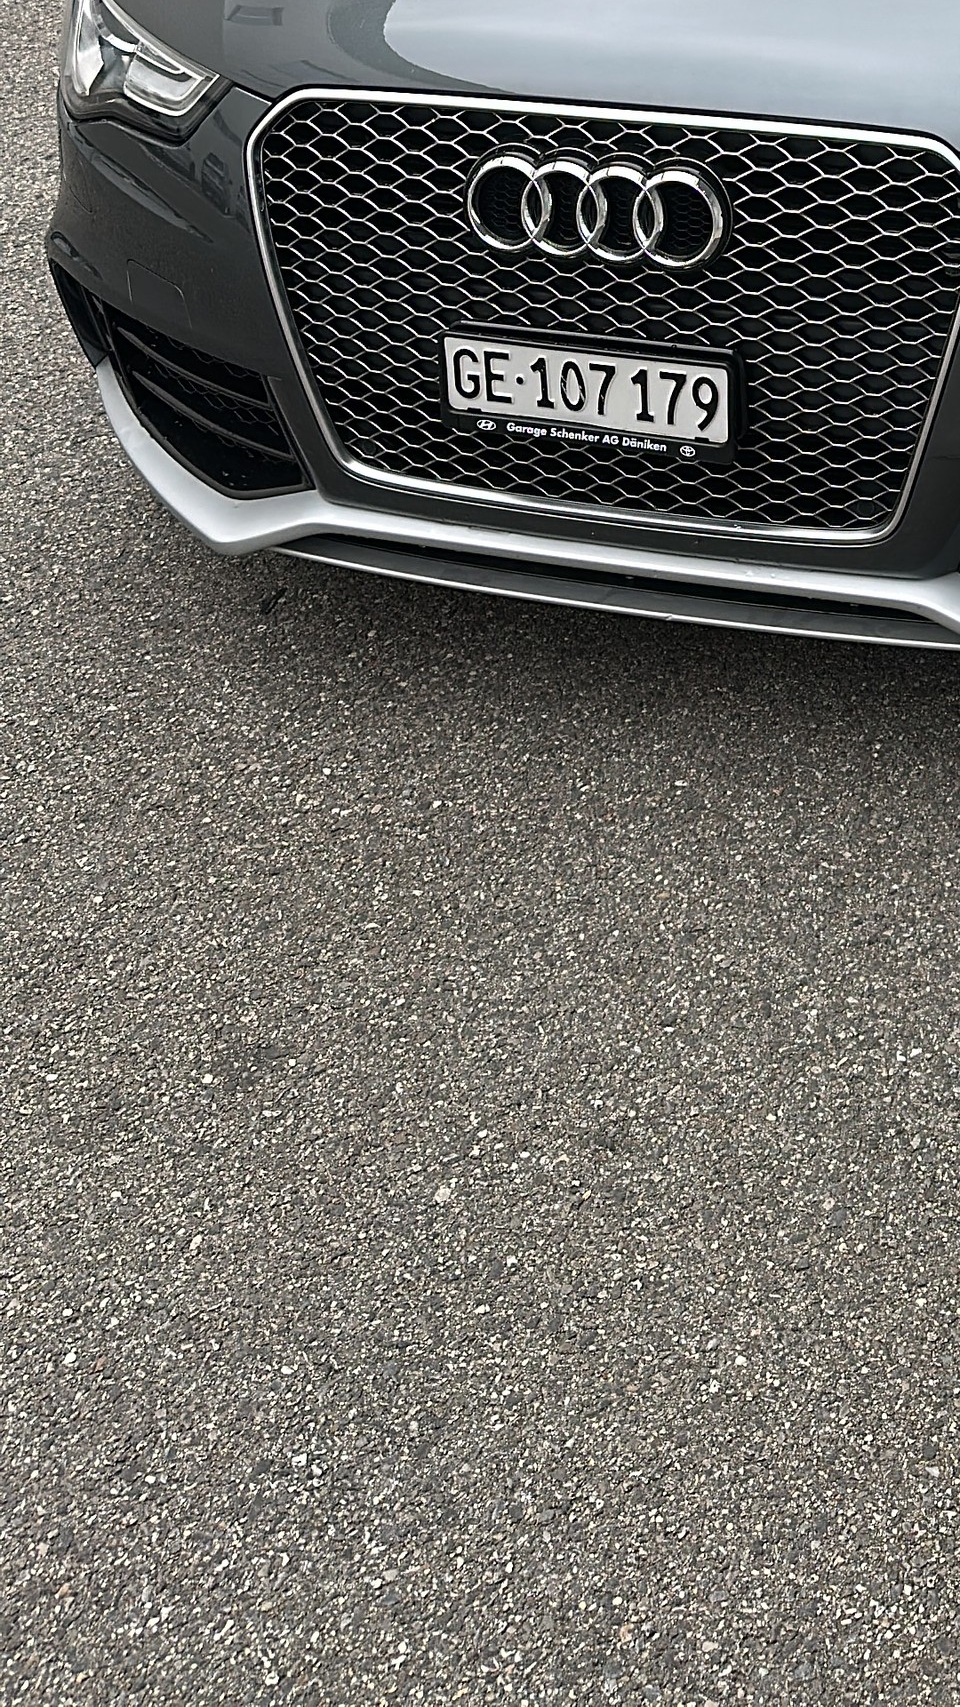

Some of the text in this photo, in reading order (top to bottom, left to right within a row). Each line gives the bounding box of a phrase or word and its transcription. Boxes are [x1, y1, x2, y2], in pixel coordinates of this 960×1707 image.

[506, 422, 667, 452] Garage Schenker AG Däniken
